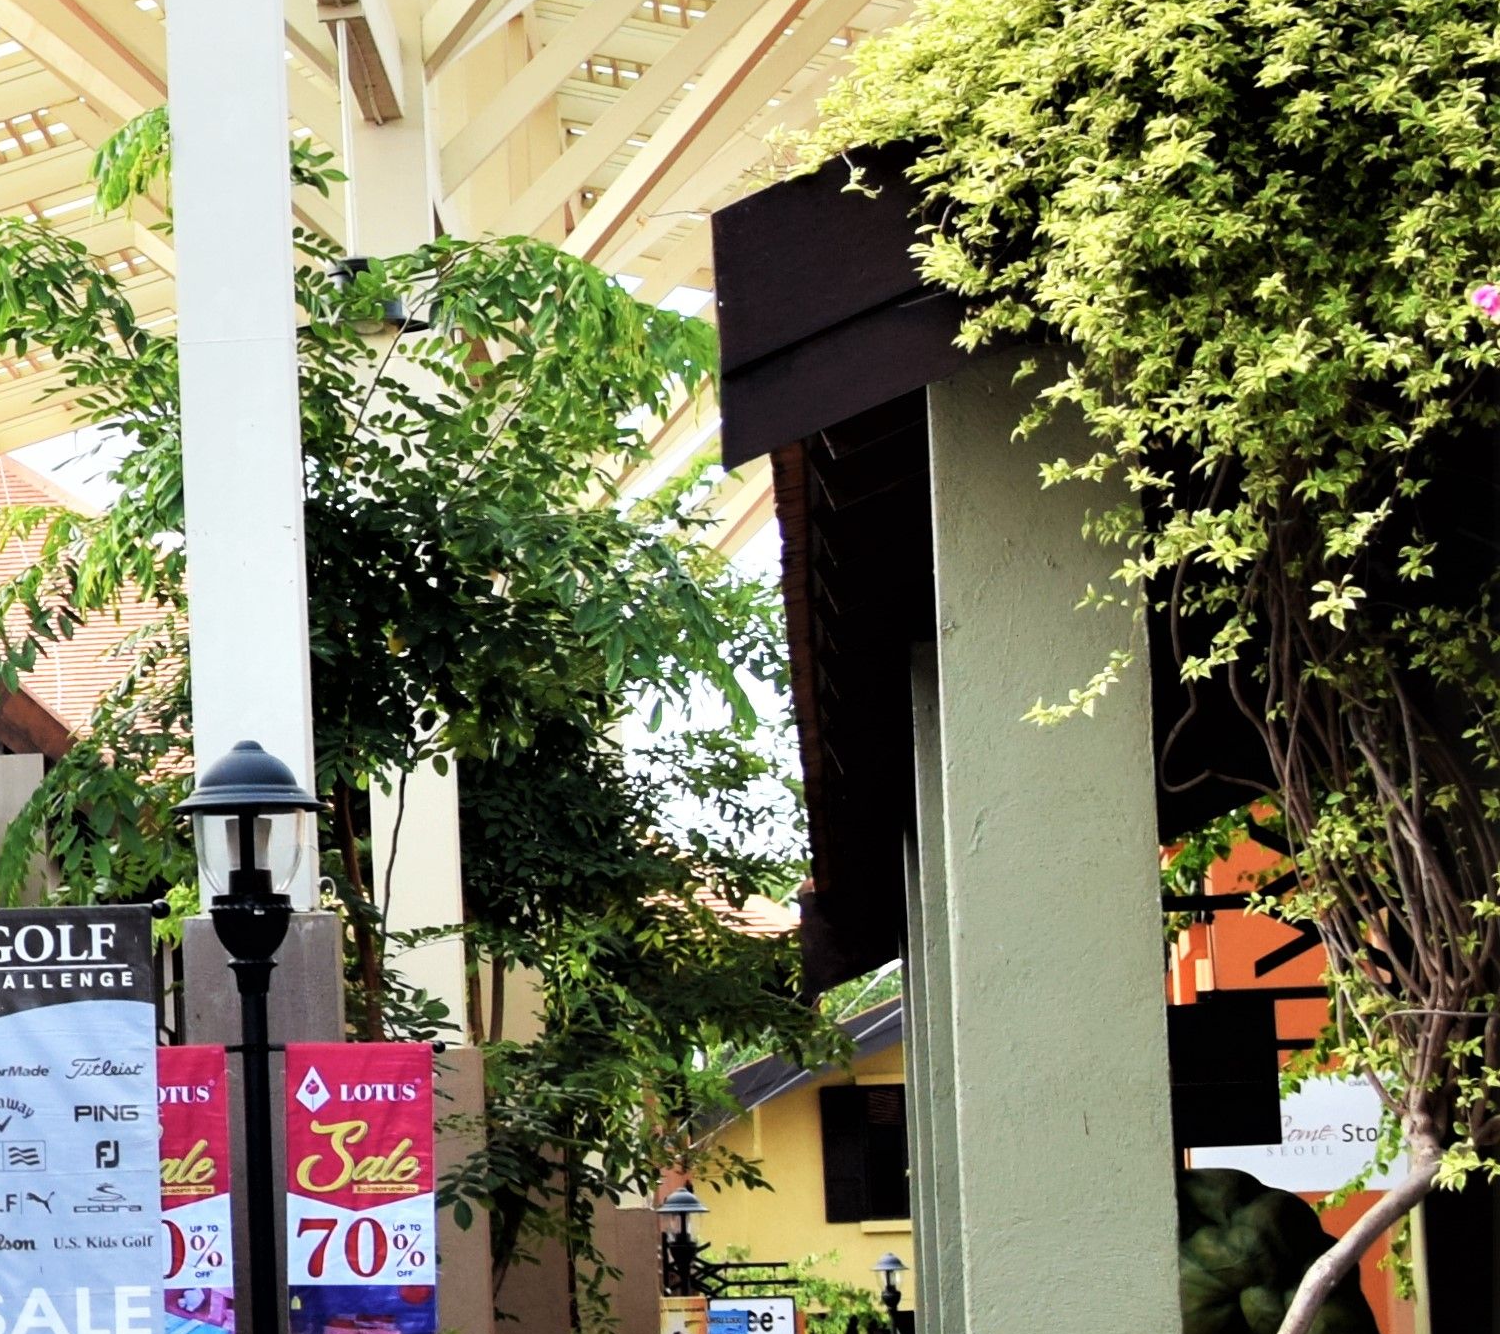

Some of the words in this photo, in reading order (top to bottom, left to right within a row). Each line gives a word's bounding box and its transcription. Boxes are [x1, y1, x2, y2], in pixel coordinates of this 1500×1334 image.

[65, 1056, 146, 1079] Titleist
[339, 1083, 417, 1102] LOTUS
[74, 1104, 139, 1123] PING
[94, 1139, 120, 1169] FJ
[296, 1118, 423, 1193] Sale
[1266, 1145, 1335, 1156] SEOUL
[160, 1138, 216, 1183] ale
[73, 1203, 142, 1214] cobra
[189, 1224, 203, 1232] UP
[207, 1223, 219, 1232] TO
[53, 1237, 82, 1250] U.S.
[86, 1235, 118, 1250] Kids
[121, 1234, 156, 1249] Golf
[296, 1216, 426, 1279] 70%
[392, 1223, 406, 1232] UP
[409, 1223, 422, 1232] TO
